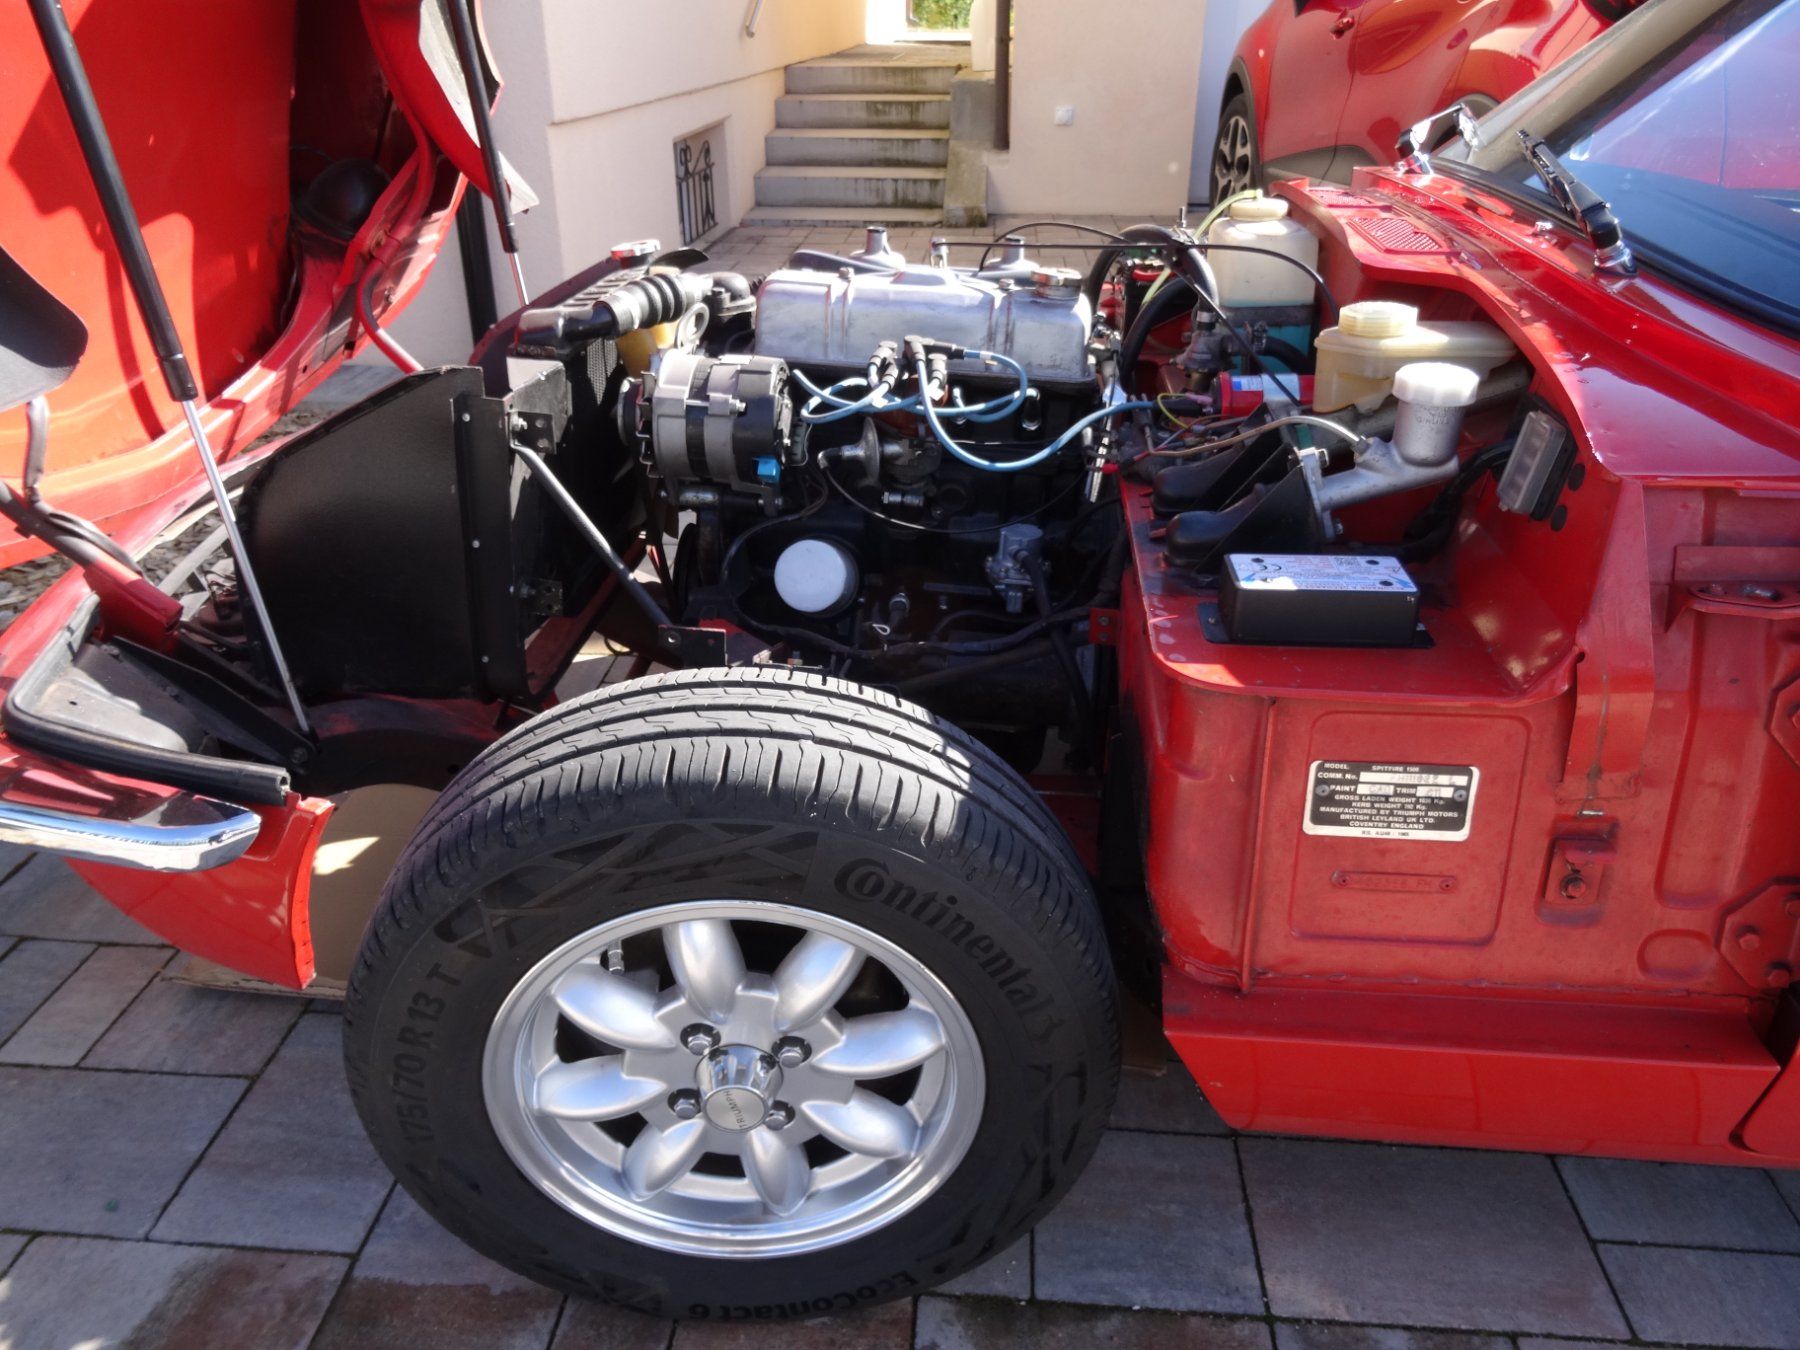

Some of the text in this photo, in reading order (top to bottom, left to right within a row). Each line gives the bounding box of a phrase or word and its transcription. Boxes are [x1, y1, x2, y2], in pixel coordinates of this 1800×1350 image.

[1330, 784, 1356, 792] PAINT
[1319, 806, 1377, 815] MANUFACTURED
[834, 858, 1055, 1017] Continental
[426, 962, 461, 986] T
[723, 1090, 748, 1128] TRIUMPH
[688, 1270, 918, 1320] EcoContact 6
